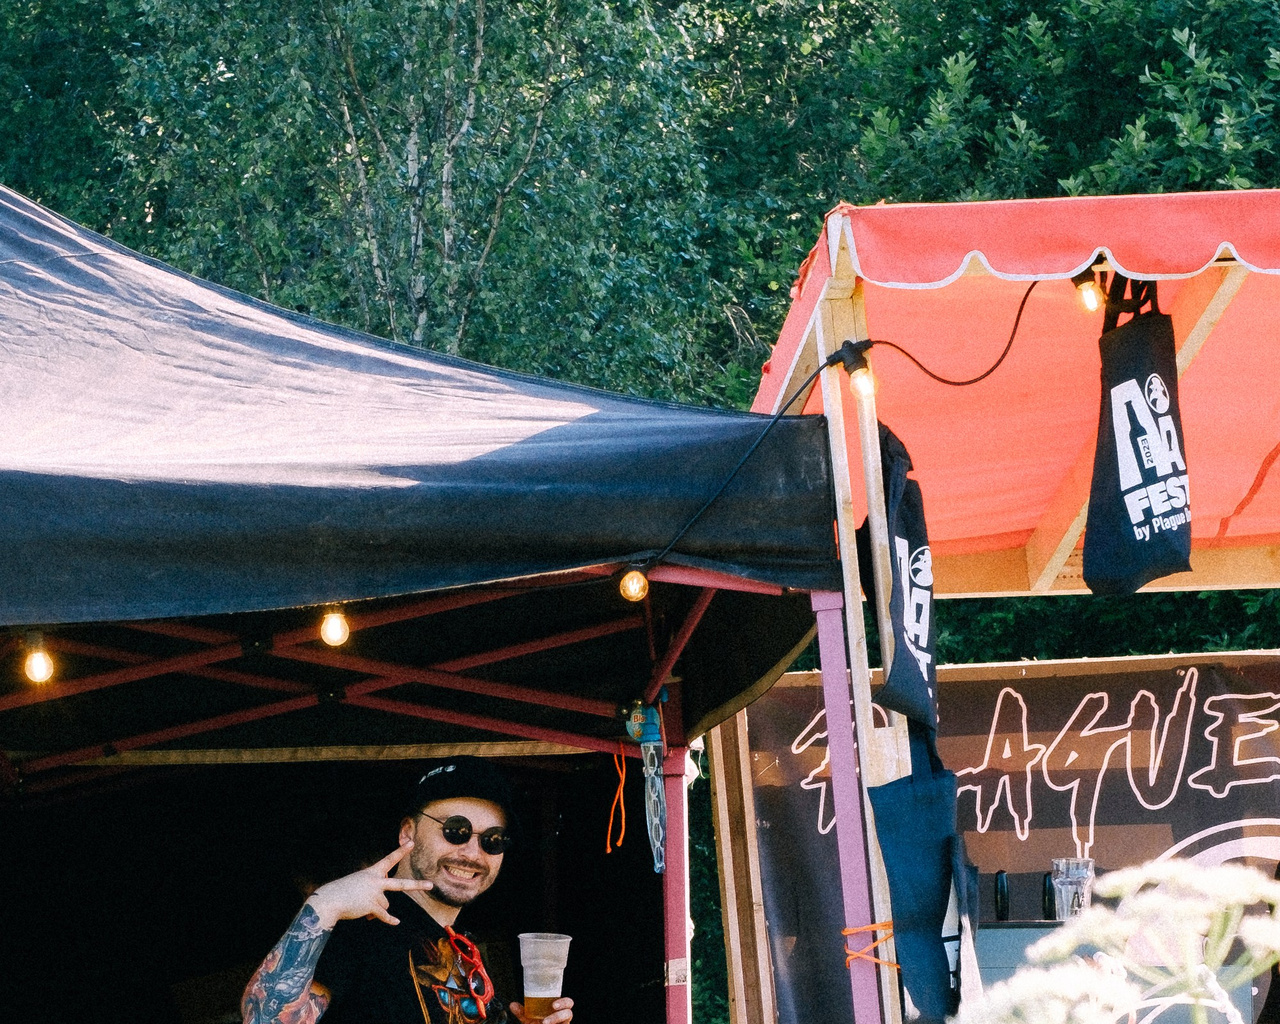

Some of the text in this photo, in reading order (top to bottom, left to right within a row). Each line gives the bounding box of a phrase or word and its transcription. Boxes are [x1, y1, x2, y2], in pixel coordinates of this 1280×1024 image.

[1140, 437, 1154, 464] 2023
[1123, 475, 1190, 525] FEST
[1133, 524, 1151, 541] by
[1152, 513, 1186, 533] Plague
[792, 667, 1280, 859] AGUE
